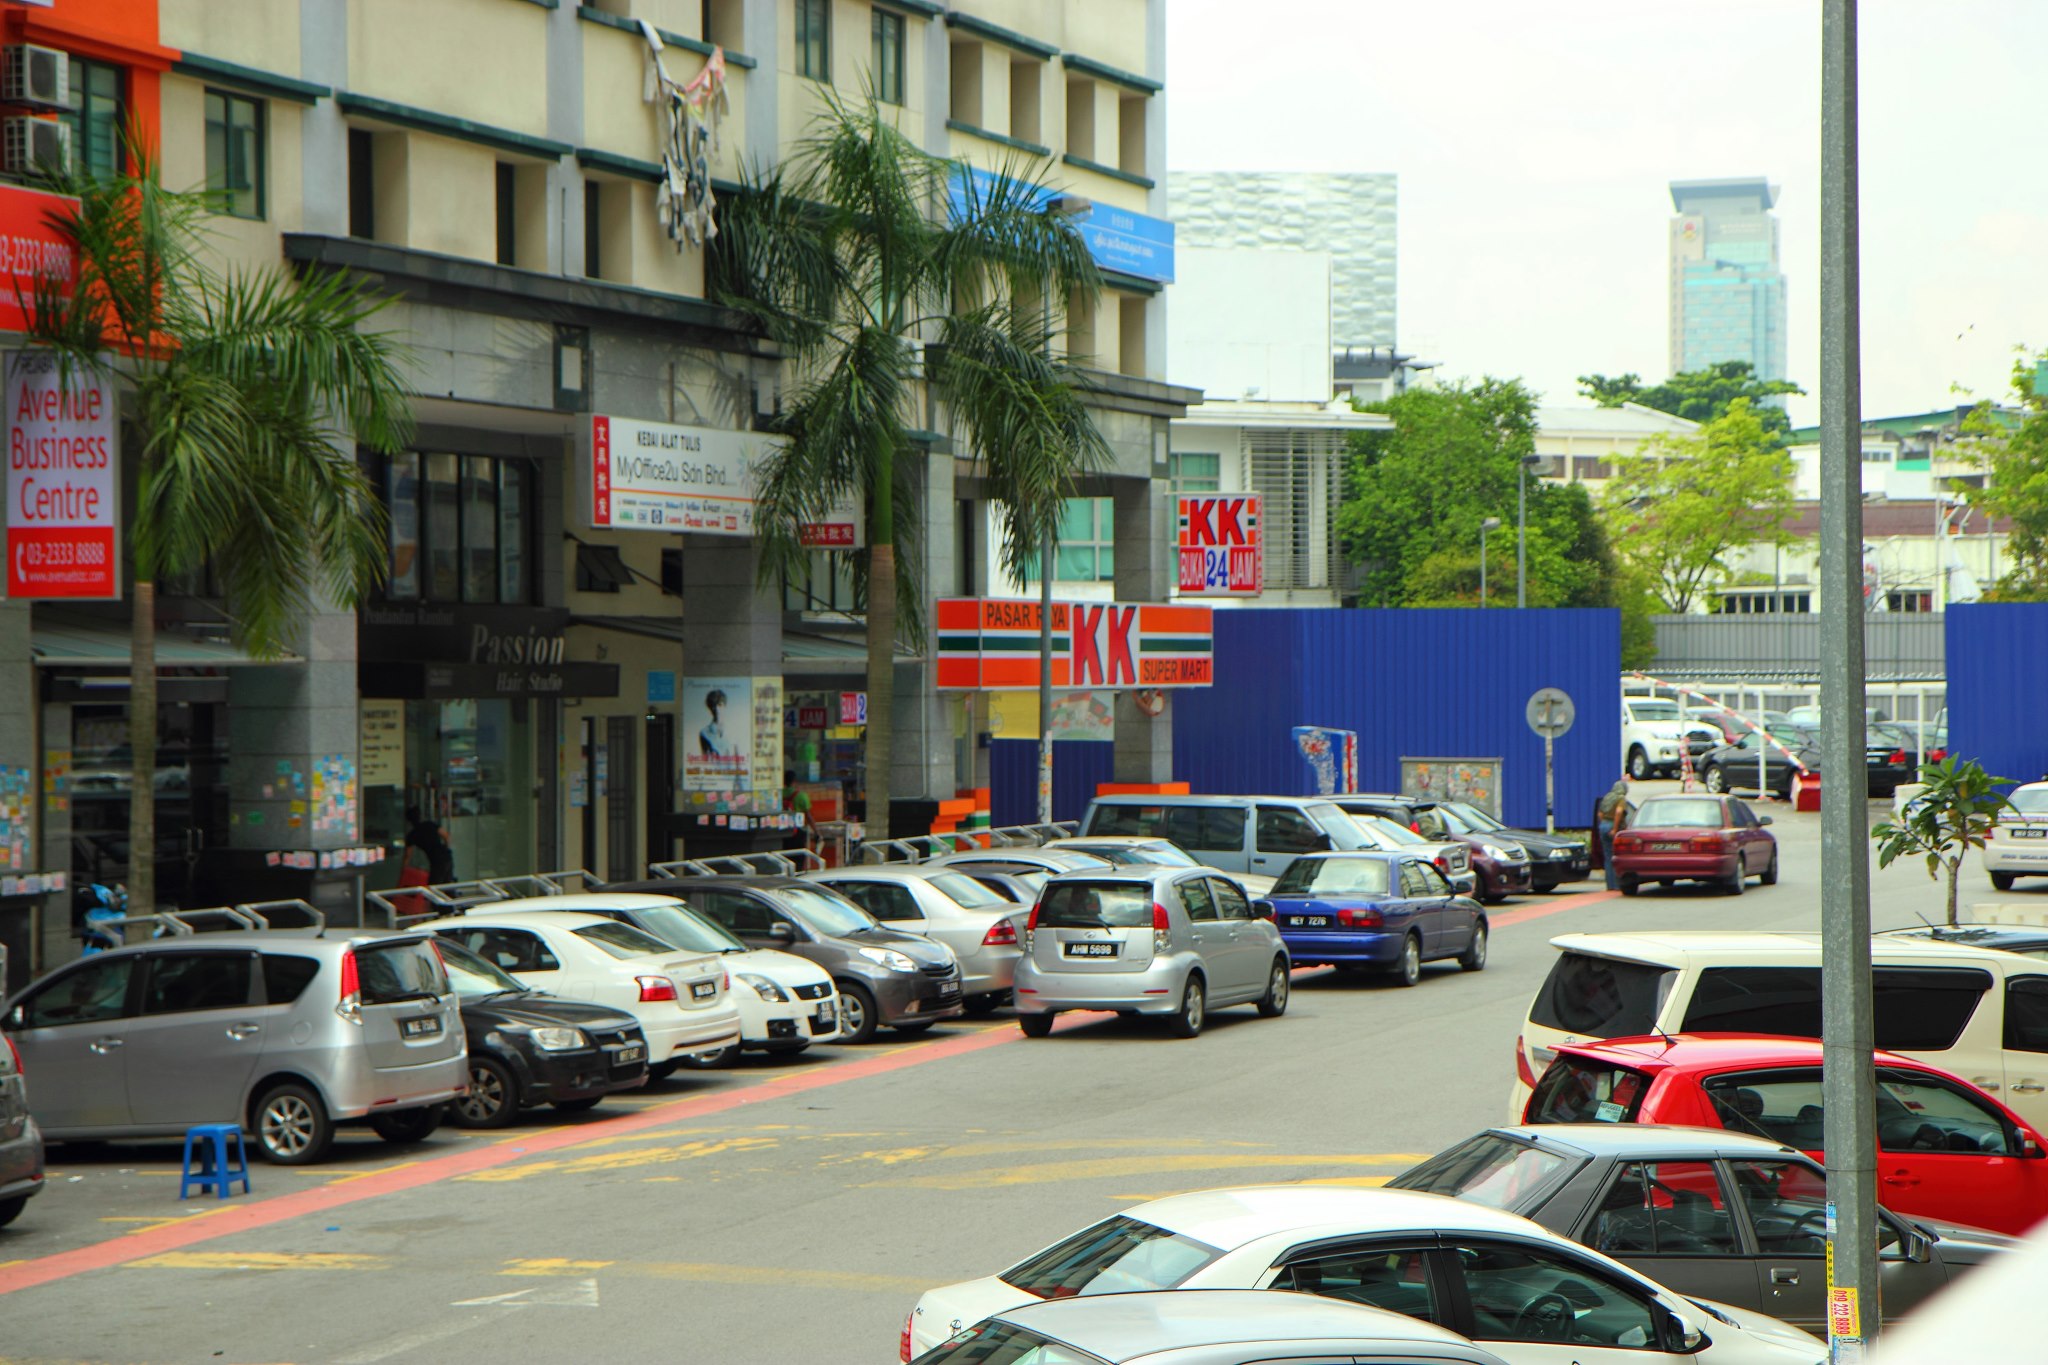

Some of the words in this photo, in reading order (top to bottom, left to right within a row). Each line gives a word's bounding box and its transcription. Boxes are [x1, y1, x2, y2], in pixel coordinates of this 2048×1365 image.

[0, 234, 42, 277] 3-2333
[16, 380, 101, 422] Avenue
[12, 426, 108, 470] Business
[617, 456, 679, 483] MyOffice2u
[681, 462, 703, 483] Sdn
[705, 463, 726, 485] Bhd
[21, 477, 99, 520] Centre
[1190, 498, 1246, 545] KK
[27, 542, 74, 565] 03-2333
[75, 542, 105, 565] 8888
[1181, 551, 1205, 586] BUKA
[1206, 549, 1228, 587] 24
[1231, 551, 1255, 586] JAM
[986, 603, 1031, 627] PASAR
[1035, 604, 1065, 628] RYA
[470, 623, 566, 665] Passion
[1073, 604, 1137, 686] KK
[496, 671, 524, 692] Hair
[528, 671, 564, 692] Studio
[1143, 659, 1178, 681] SUPER
[1180, 660, 1209, 681] MART
[801, 711, 825, 726] JAM
[1834, 1290, 1848, 1302] 019
[1834, 1303, 1849, 1316] 232
